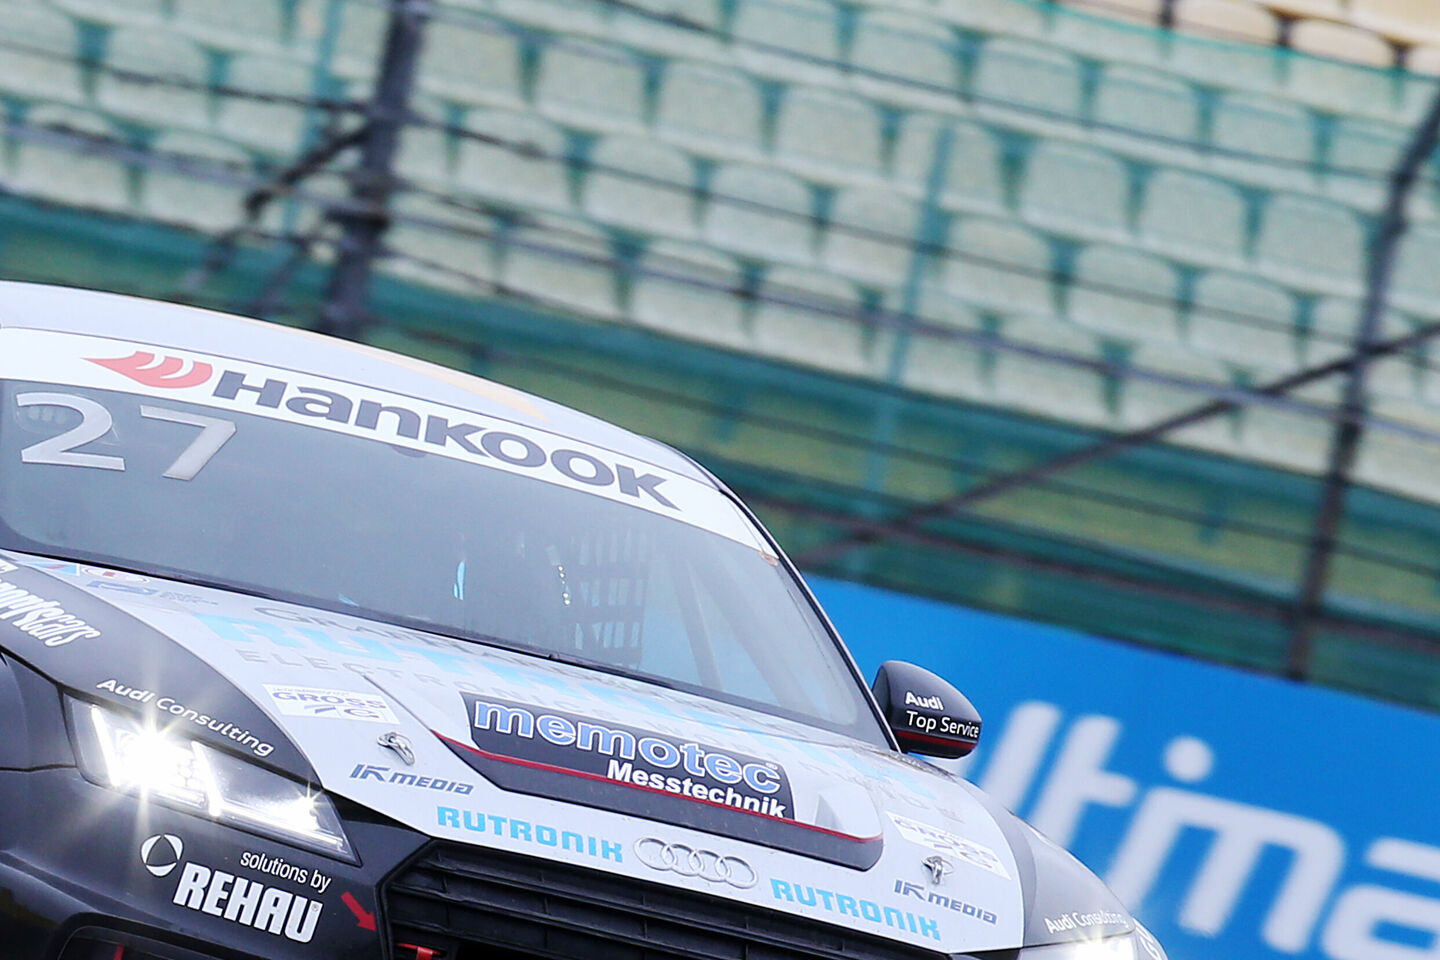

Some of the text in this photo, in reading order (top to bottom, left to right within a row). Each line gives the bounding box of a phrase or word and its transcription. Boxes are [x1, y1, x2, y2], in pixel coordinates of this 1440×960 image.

[16, 392, 237, 481] 27
[96, 679, 275, 758] Audi Consulting
[905, 691, 944, 710] Audi
[906, 710, 979, 738] Top Service
[474, 700, 781, 794] memotec
[607, 759, 787, 818] Messtechnik
[437, 806, 623, 863] RUTRONIK
[241, 850, 333, 894] solutions by
[172, 862, 324, 943] REHAU
[770, 878, 941, 941] RUTRONIK
[1044, 912, 1077, 934] Audi
